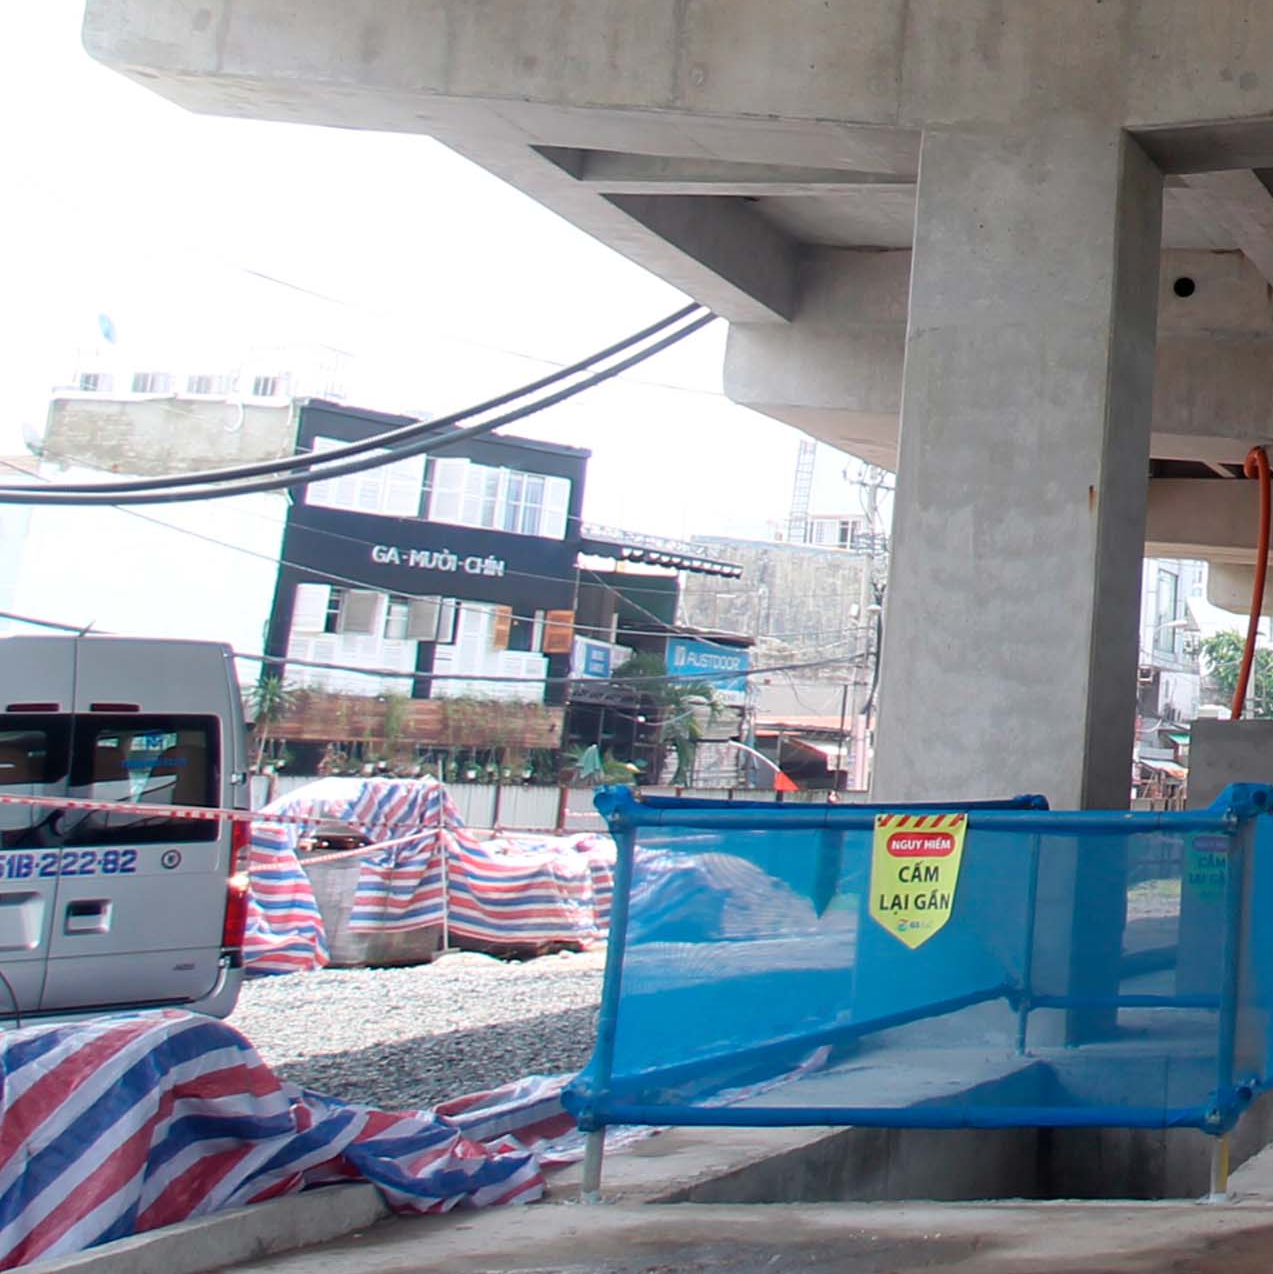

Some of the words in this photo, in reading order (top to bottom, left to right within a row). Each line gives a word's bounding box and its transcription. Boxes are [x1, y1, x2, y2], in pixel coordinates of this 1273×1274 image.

[891, 839, 922, 850] NGUY
[898, 859, 939, 883] CẤM
[880, 893, 909, 915] LẠI
